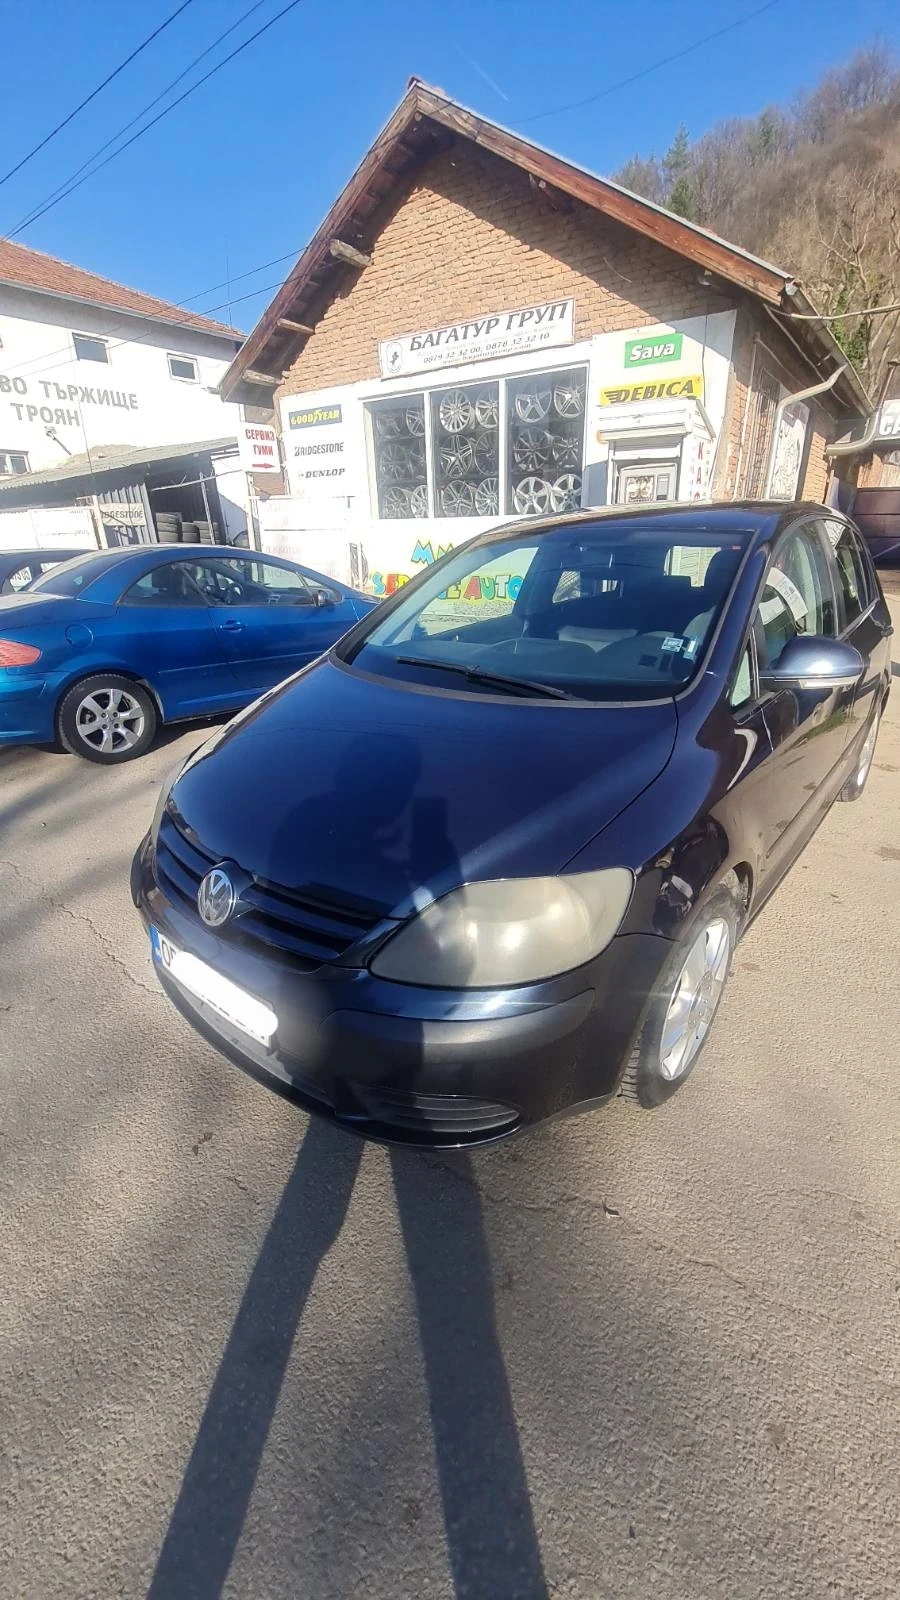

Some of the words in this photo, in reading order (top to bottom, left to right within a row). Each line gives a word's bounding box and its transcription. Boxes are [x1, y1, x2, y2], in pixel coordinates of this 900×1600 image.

[410, 318, 499, 352] БАГАТУР
[505, 302, 568, 331] ГРУП
[486, 341, 508, 351] 0878
[629, 343, 675, 362] Sava
[38, 380, 139, 411] ТЪРЖИЩЕ
[10, 402, 80, 427] ТРОЯН
[290, 408, 340, 426] GOODYEAR
[245, 428, 275, 442] СЕРВИЗ
[253, 444, 274, 457] ГУМИ
[294, 442, 344, 457] BRIDGESTONE
[305, 468, 346, 479] DUNLOP
